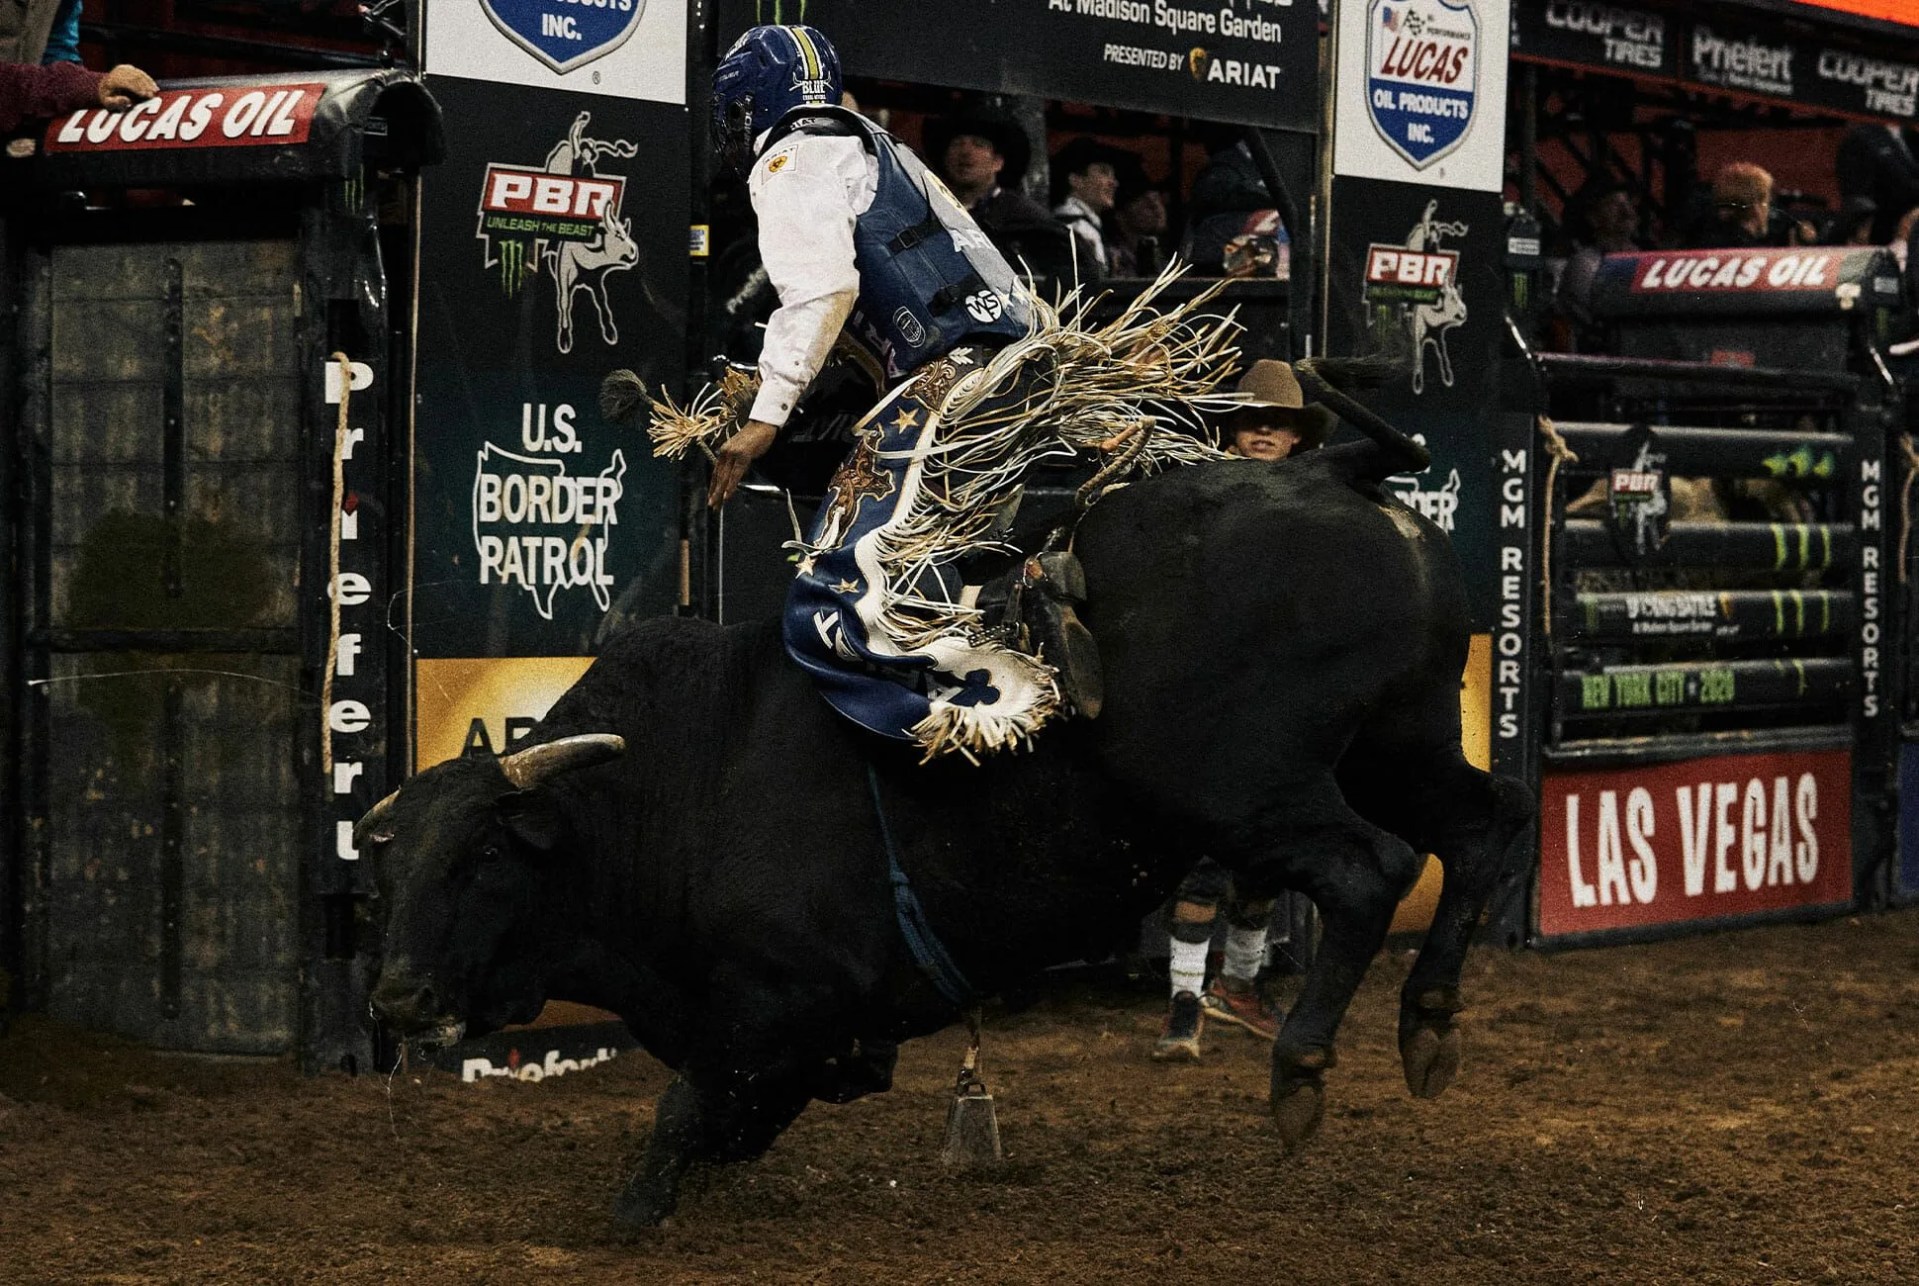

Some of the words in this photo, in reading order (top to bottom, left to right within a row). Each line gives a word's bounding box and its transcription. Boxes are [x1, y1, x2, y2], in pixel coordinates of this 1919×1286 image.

[542, 13, 582, 40] INC.
[1077, 0, 1150, 24] Madison
[1155, 0, 1216, 36] Square
[1220, 8, 1282, 43] Garden
[1103, 43, 1167, 70] PRESENTED
[1168, 53, 1185, 71] BY
[1207, 58, 1281, 90] ARIAT
[1380, 36, 1468, 84] LUCAS
[1604, 38, 1662, 68] TIRES
[802, 79, 826, 94] BLUE
[1373, 88, 1397, 110] OIL
[1399, 92, 1468, 120] PRODUCTS
[57, 92, 223, 144] LUCAS
[222, 89, 305, 139] OIL
[1407, 122, 1435, 144] INC.
[490, 172, 615, 218] PBR
[487, 216, 540, 233] UNLEASH
[541, 221, 557, 233] THE
[558, 222, 595, 237] BEAST
[1370, 250, 1453, 286] PBR
[1641, 256, 1767, 289] LUCAS
[1767, 254, 1831, 287] OIL
[521, 402, 582, 454] U.S.
[478, 473, 618, 526] BORDER
[1501, 449, 1526, 529] MGM
[1861, 459, 1881, 531] MGM
[479, 535, 615, 586] PATROL
[324, 360, 374, 861] Priefert
[1862, 546, 1880, 717] RESORTS
[1499, 546, 1523, 739] RESORTS
[1566, 786, 1658, 908] LAS
[1676, 772, 1819, 897] VEGAS
